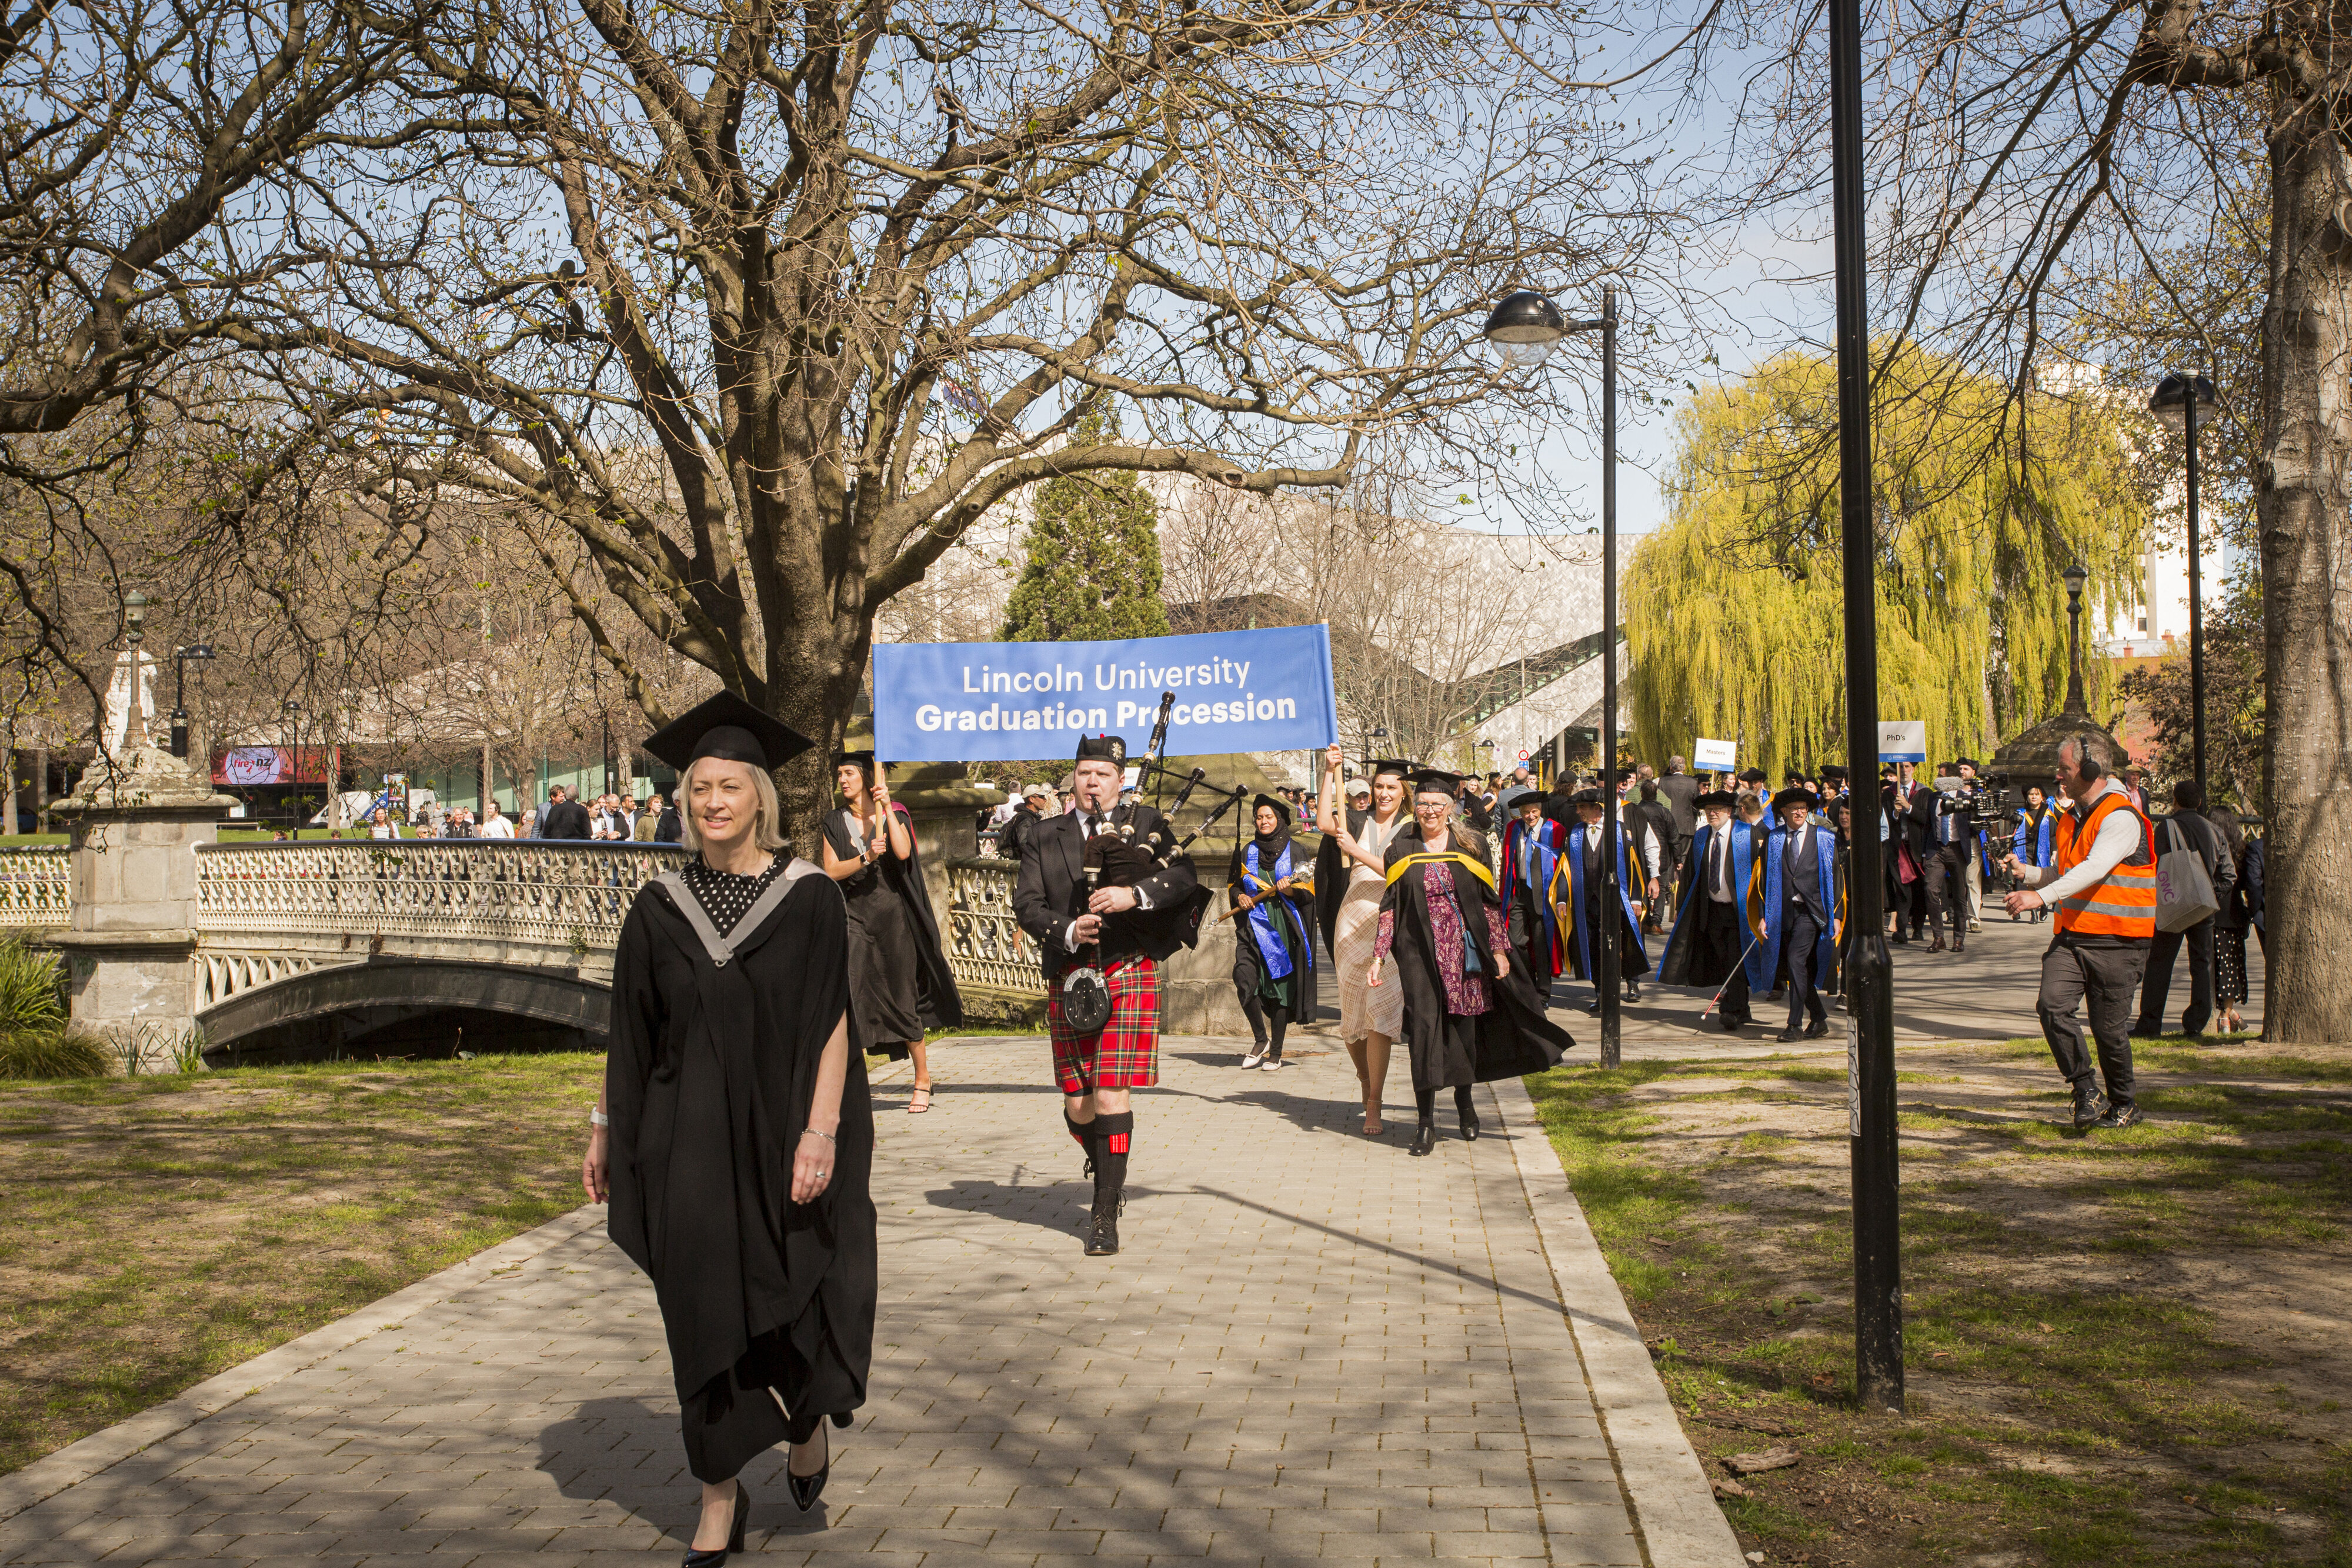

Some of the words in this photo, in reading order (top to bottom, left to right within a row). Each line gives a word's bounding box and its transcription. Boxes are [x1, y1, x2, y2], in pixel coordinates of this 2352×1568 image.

[963, 663, 1083, 693] Lincoln
[1095, 655, 1251, 691] University
[915, 702, 1107, 732] Graduation
[234, 759, 249, 768] fire
[2157, 870, 2175, 903] GWC
